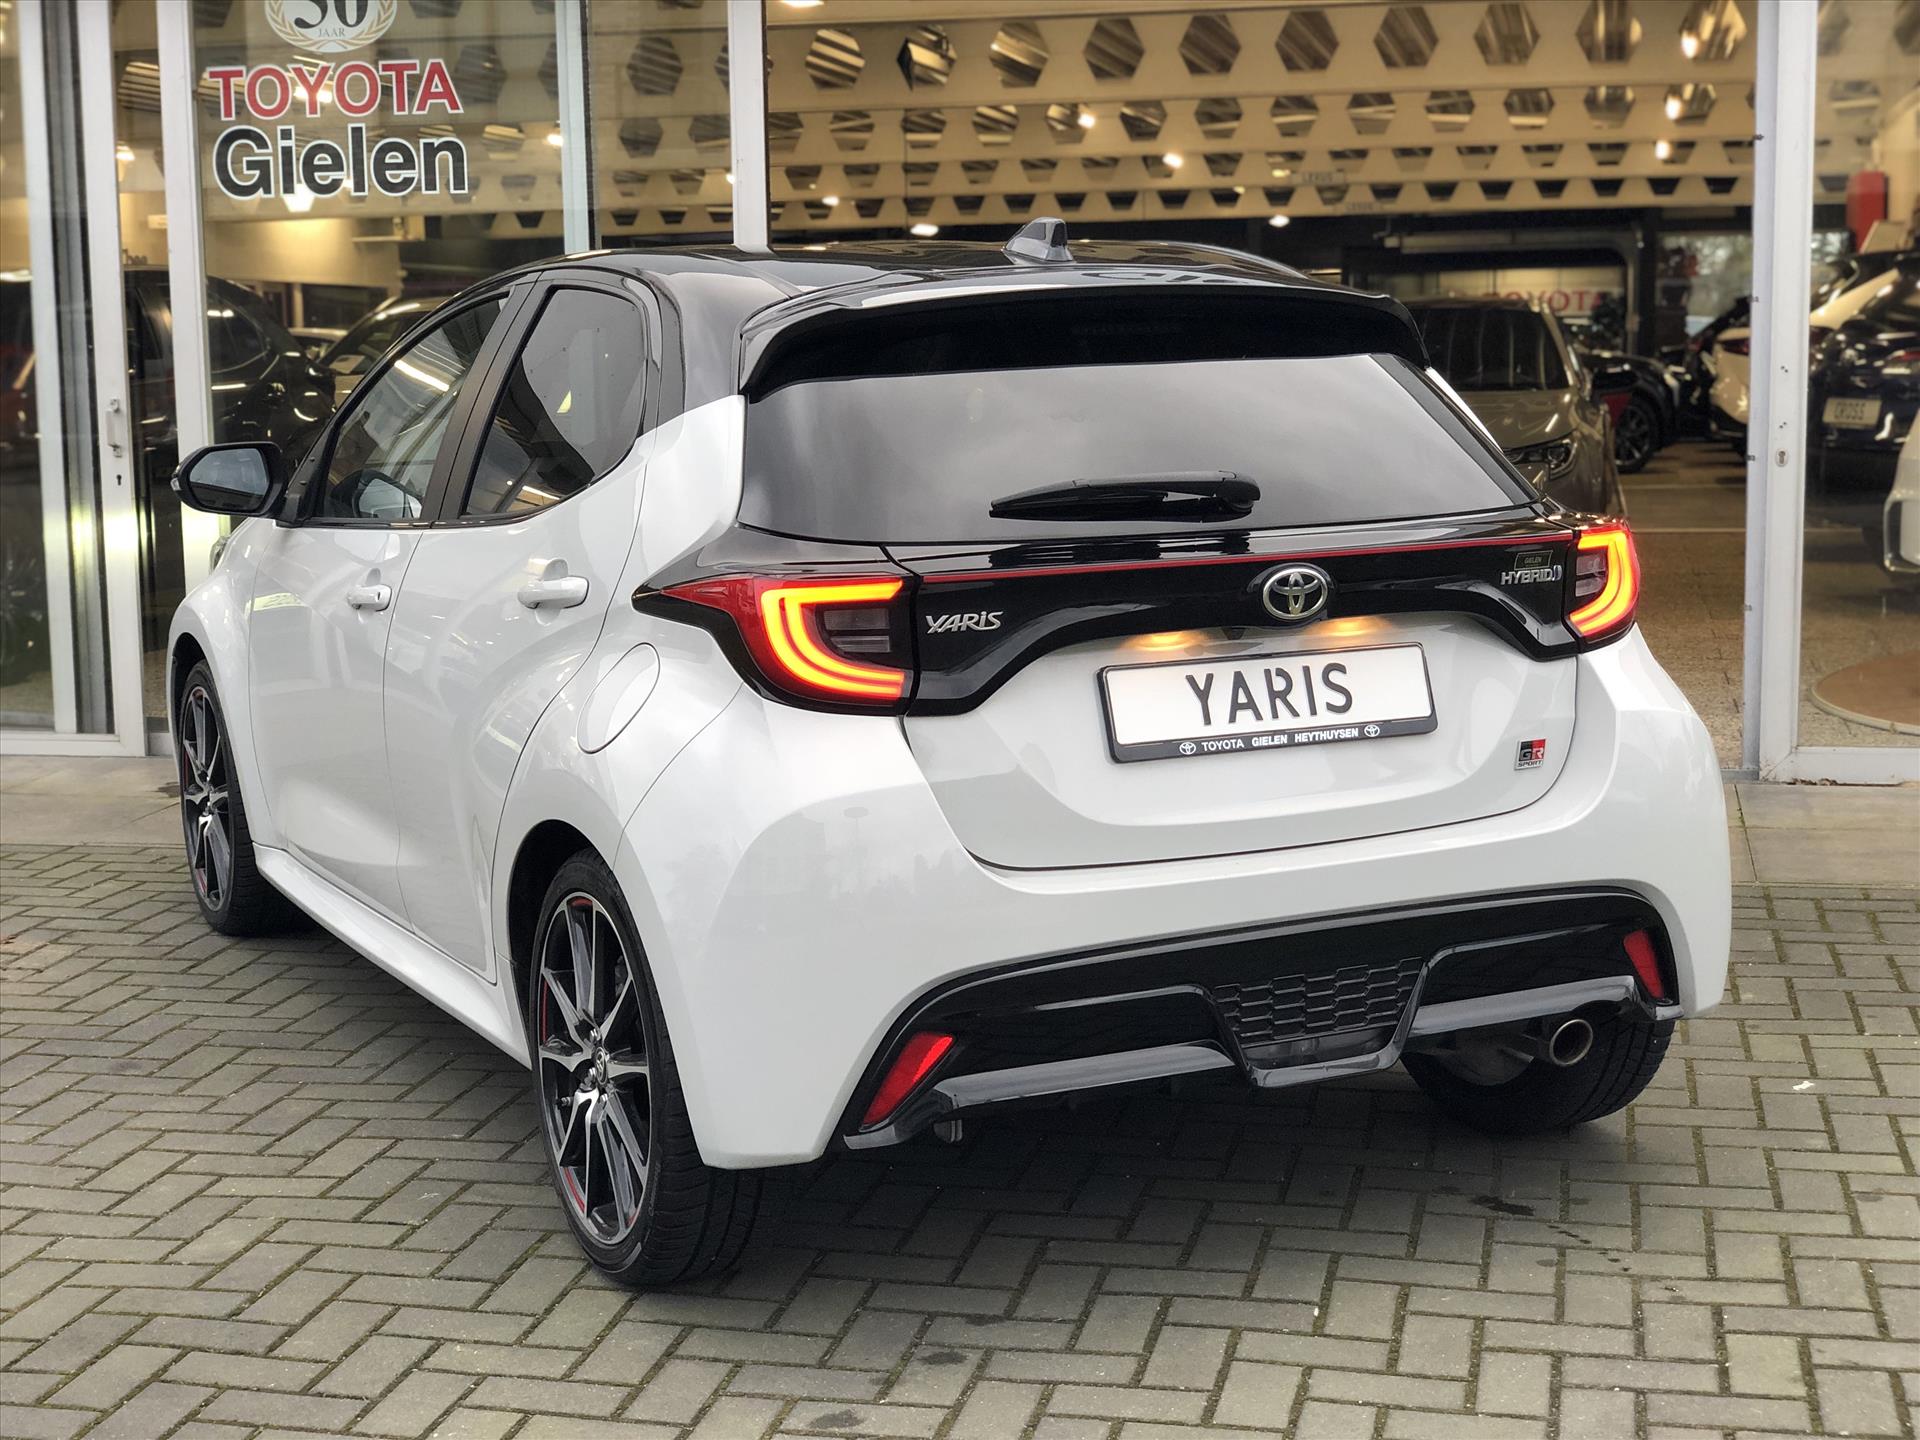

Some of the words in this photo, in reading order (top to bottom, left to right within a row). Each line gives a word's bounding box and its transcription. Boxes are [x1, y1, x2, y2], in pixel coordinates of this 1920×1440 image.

[318, 28, 346, 38] JAAR
[207, 58, 464, 120] TOYOTA
[213, 123, 469, 200] Gielen
[1500, 568, 1553, 585] HYBRID
[1185, 662, 1353, 726] YARIS
[1201, 738, 1245, 752] TOYOTA
[1251, 734, 1288, 748] GIELEN
[1294, 727, 1359, 743] HEYTHUYSEN
[1517, 760, 1543, 768] SPORT
[1520, 748, 1544, 760] GR
